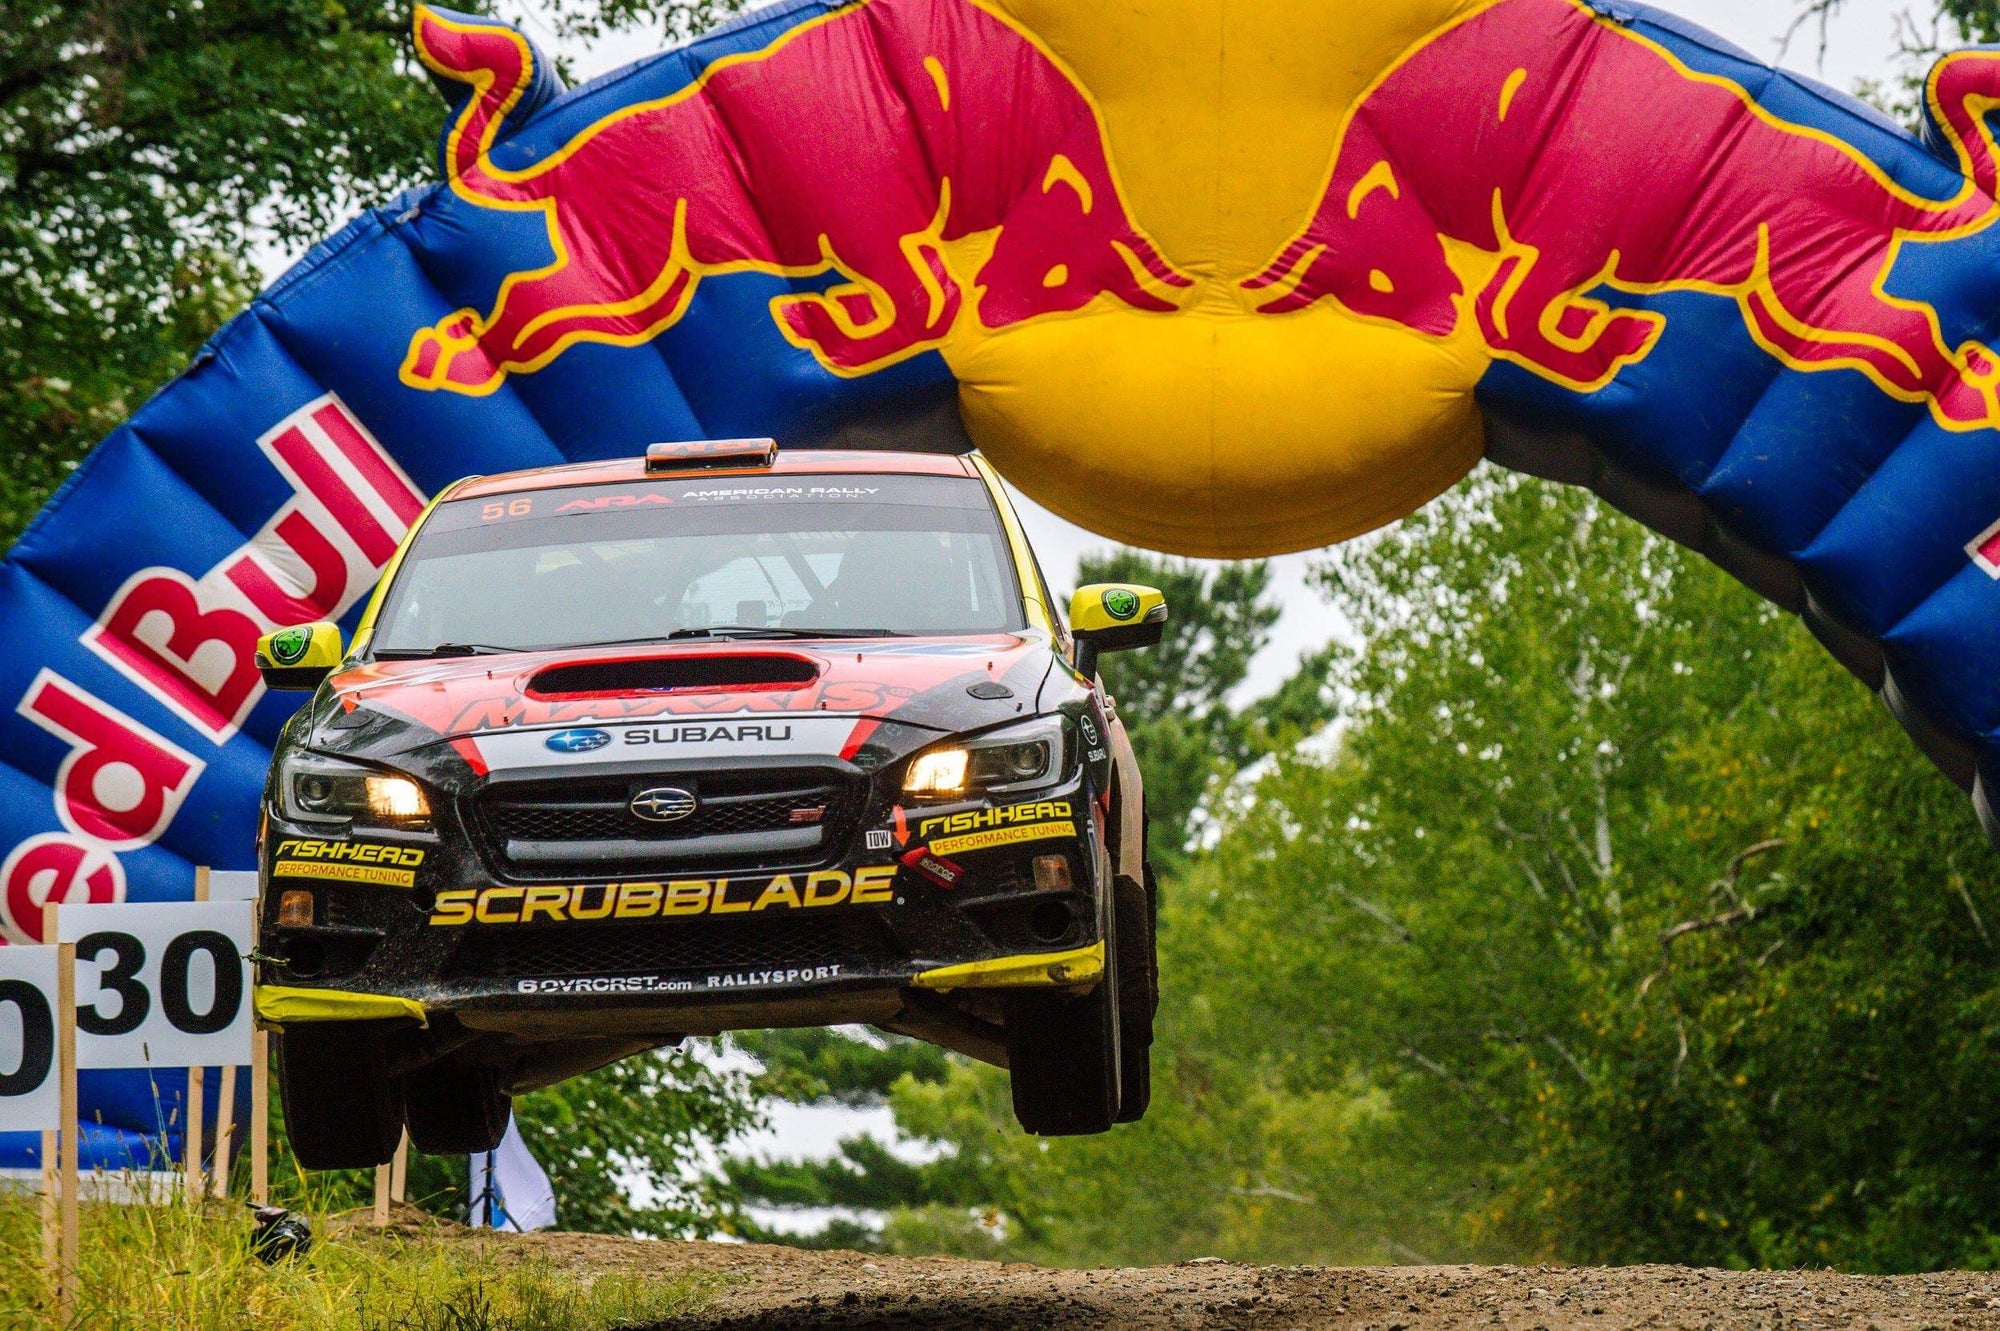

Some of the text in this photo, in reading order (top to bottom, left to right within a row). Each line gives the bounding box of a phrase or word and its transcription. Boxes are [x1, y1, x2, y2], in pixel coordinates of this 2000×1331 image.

[682, 487, 880, 498] AMERICAN RALLY
[481, 493, 674, 521] 56 ARA
[0, 390, 430, 945] ed Bull
[624, 725, 791, 746] SUBARU
[920, 801, 1072, 837] FISHHEAD
[868, 831, 889, 848] TOW
[934, 822, 1074, 852] PERFORMANCE TUNING
[276, 840, 425, 867] FISHHEAD
[277, 863, 410, 884] PERFORMANCE TUNING
[429, 865, 898, 926] SCRUBBLADE
[75, 930, 243, 1036] 30
[708, 964, 841, 988] RALLYSPORT
